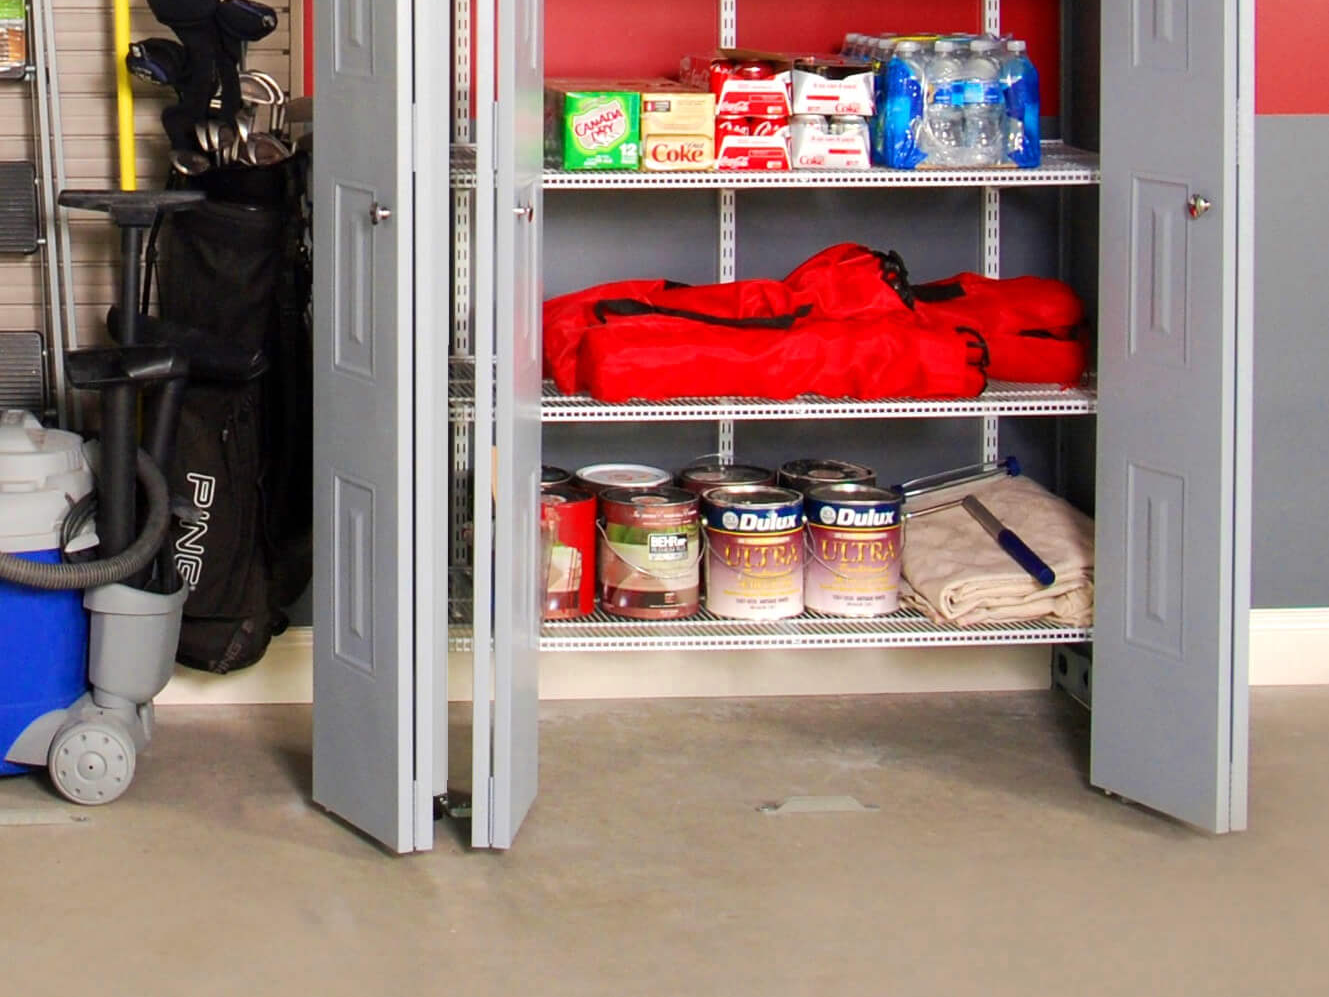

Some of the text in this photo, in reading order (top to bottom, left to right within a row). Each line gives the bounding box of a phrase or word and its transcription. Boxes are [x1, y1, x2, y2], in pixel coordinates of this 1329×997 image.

[575, 108, 623, 137] CANADA
[652, 144, 704, 163] Coke
[739, 513, 797, 531] Dulux
[837, 508, 895, 526] Dulux
[651, 536, 677, 547] BEHR
[821, 539, 896, 563] ULTRA
[725, 543, 799, 568] ULTRA
